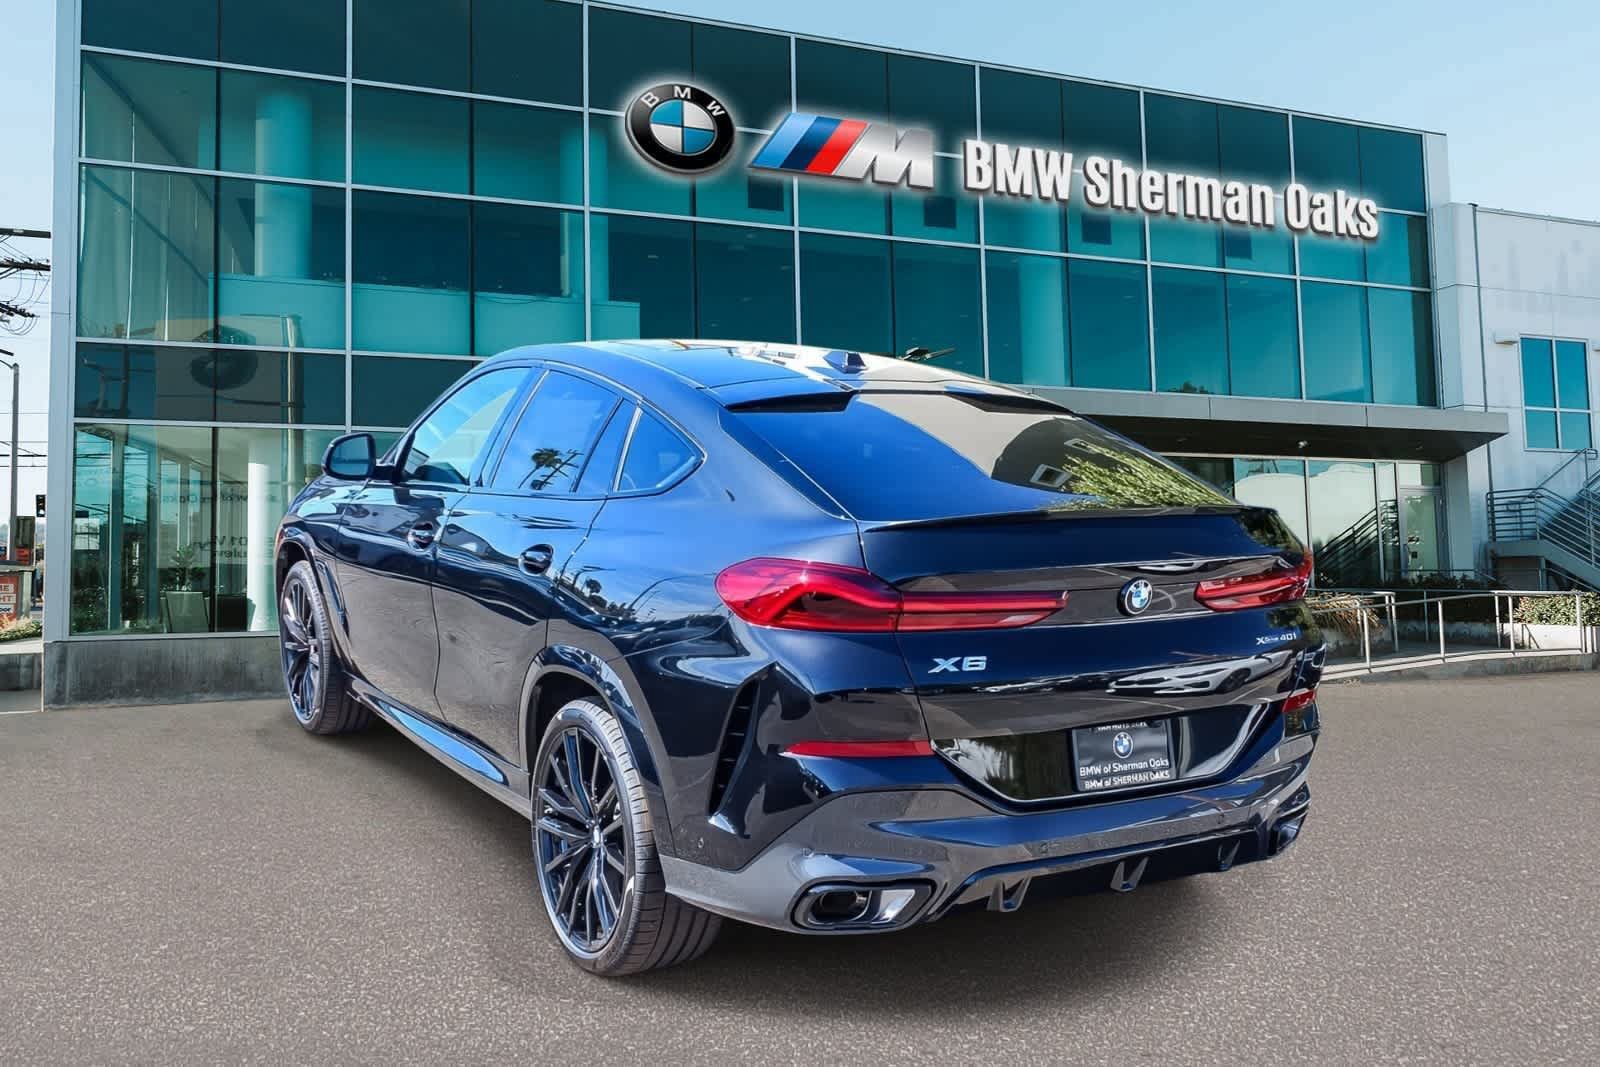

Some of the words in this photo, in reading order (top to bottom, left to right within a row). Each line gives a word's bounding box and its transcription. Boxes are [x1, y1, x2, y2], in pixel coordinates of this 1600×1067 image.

[640, 85, 725, 117] BMW
[832, 122, 935, 189] M
[963, 139, 1073, 201] BMW
[1083, 156, 1275, 227] Sherman
[1284, 183, 1379, 240] Oaks
[927, 655, 988, 674] X6
[1079, 765, 1102, 777] BMW
[1103, 764, 1111, 773] of
[1112, 761, 1148, 773] Sherman
[1149, 757, 1169, 769] Oaks
[1149, 770, 1170, 780] OAKS
